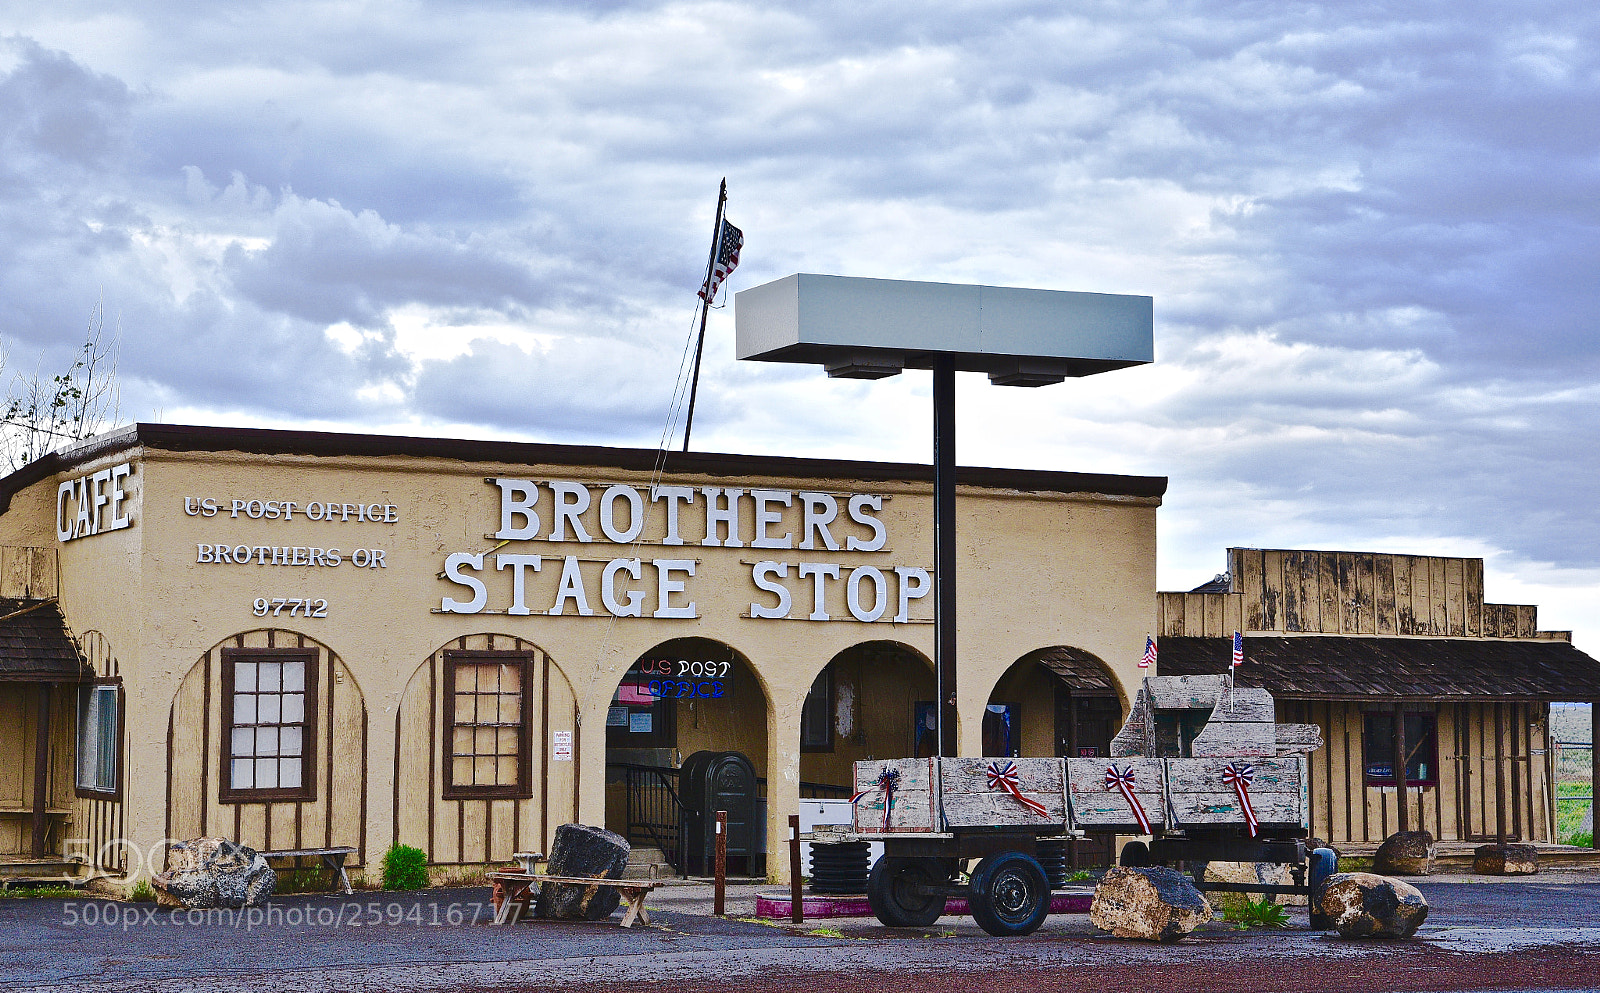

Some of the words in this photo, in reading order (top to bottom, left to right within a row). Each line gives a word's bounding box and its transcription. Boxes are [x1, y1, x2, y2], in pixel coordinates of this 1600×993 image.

[56, 462, 131, 542] CAFE
[184, 497, 218, 517] US
[231, 499, 297, 521] POST
[306, 501, 399, 523] OFFICE
[495, 477, 888, 551] BROTHERS
[196, 544, 342, 567] BROTHERS
[352, 548, 387, 568] OR
[440, 553, 697, 618] STAGE
[750, 561, 932, 623] STOP
[253, 598, 328, 618] 97712
[641, 659, 672, 675] US
[678, 660, 731, 678] POST
[648, 680, 725, 698] OFFICE
